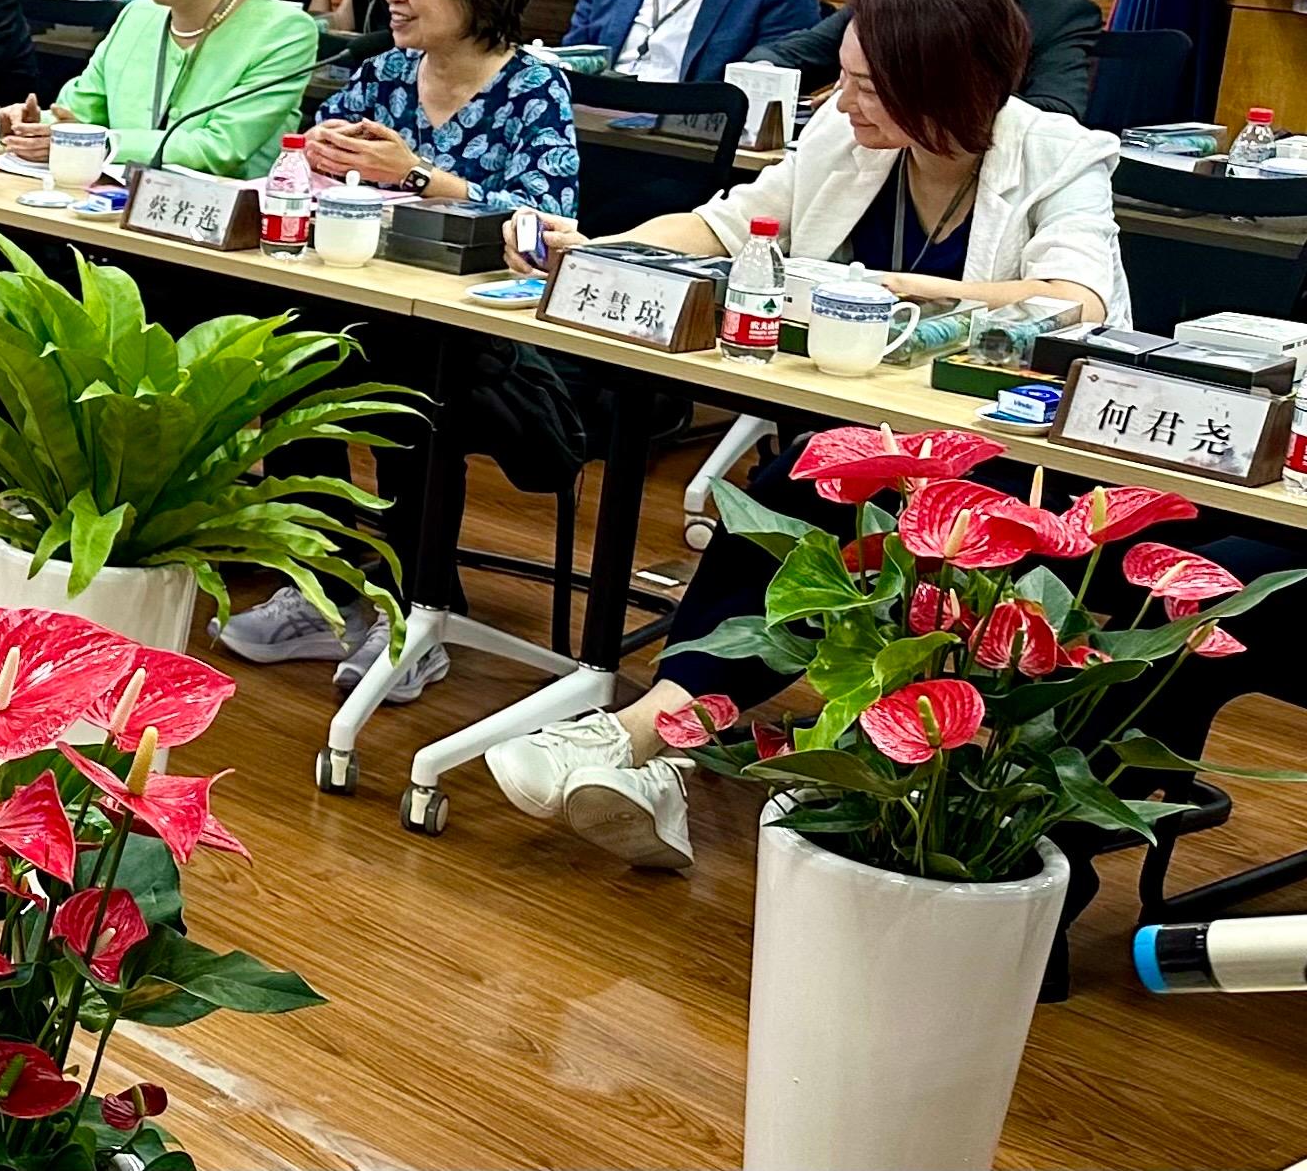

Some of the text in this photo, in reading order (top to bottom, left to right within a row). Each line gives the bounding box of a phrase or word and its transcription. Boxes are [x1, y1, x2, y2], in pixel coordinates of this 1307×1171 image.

[147, 194, 221, 232] 蔡若莲
[571, 284, 666, 329] 李慧琼
[1097, 398, 1234, 456] 何君尧
